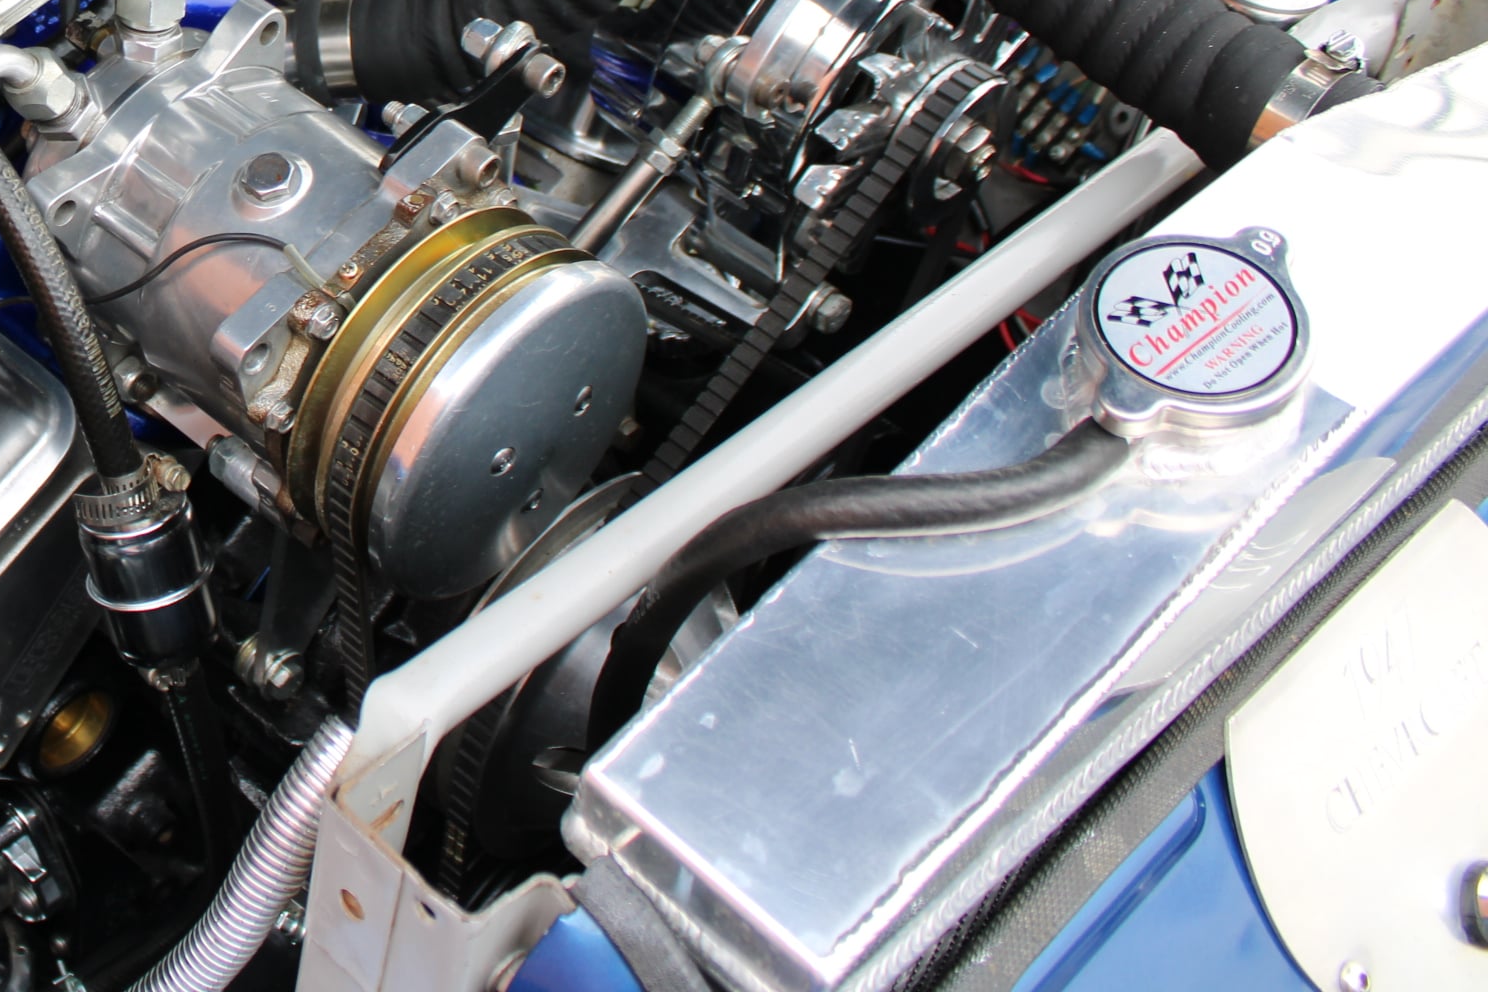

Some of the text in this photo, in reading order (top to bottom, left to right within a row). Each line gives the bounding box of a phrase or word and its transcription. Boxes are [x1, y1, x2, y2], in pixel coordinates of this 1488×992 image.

[1128, 268, 1256, 368] Champion
[1165, 293, 1275, 380] www.ChampionCooling.com
[1203, 321, 1289, 389] Do Not Open When Hot
[1204, 324, 1264, 370] WARNING
